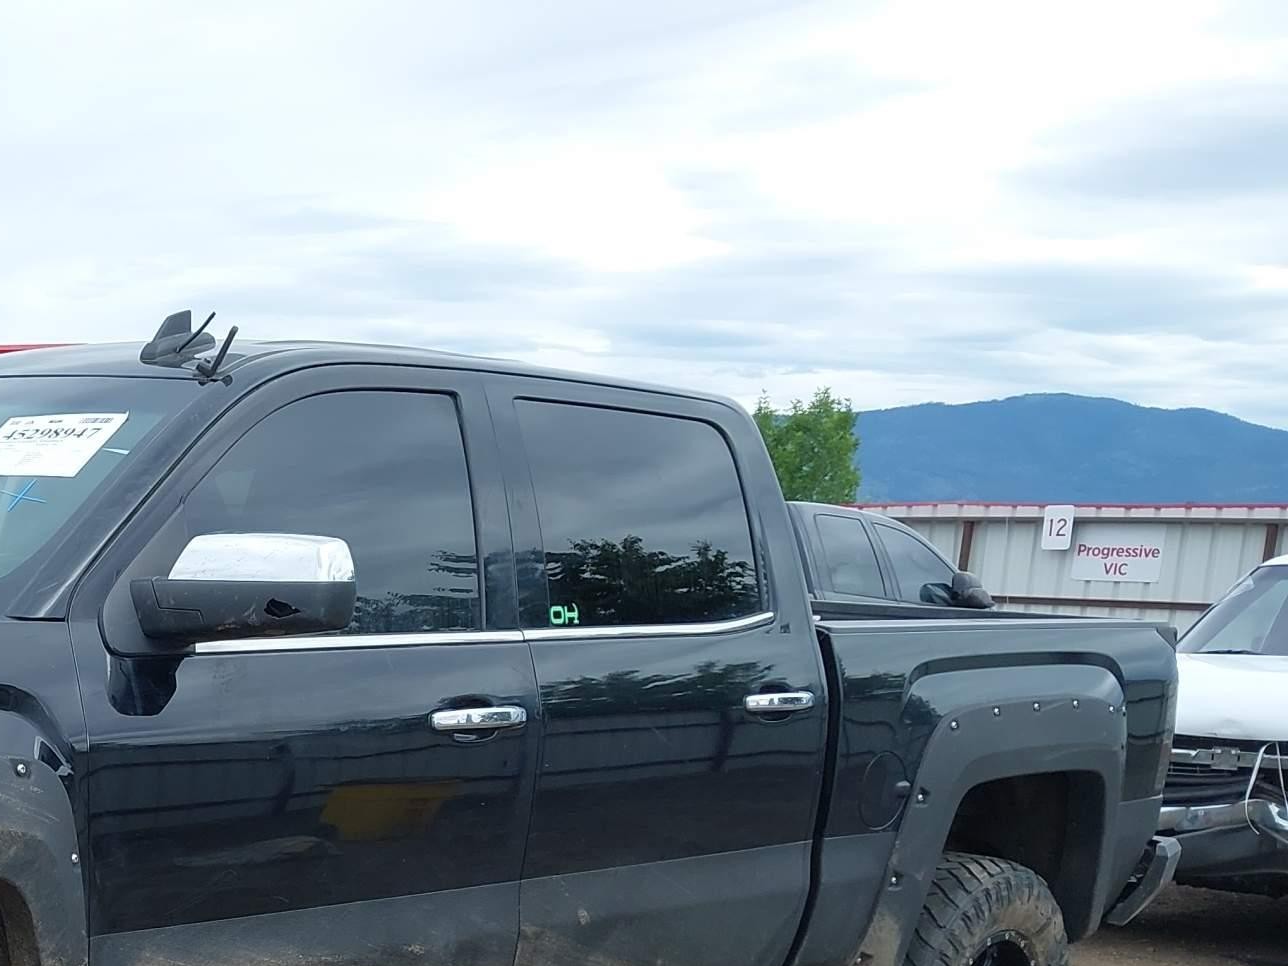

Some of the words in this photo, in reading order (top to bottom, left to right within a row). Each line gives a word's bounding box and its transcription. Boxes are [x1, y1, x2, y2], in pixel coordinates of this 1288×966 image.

[2, 427, 102, 441] 45298947
[1048, 518, 1068, 537] 12
[1077, 543, 1161, 560] Progressive
[1103, 562, 1129, 576] VIC
